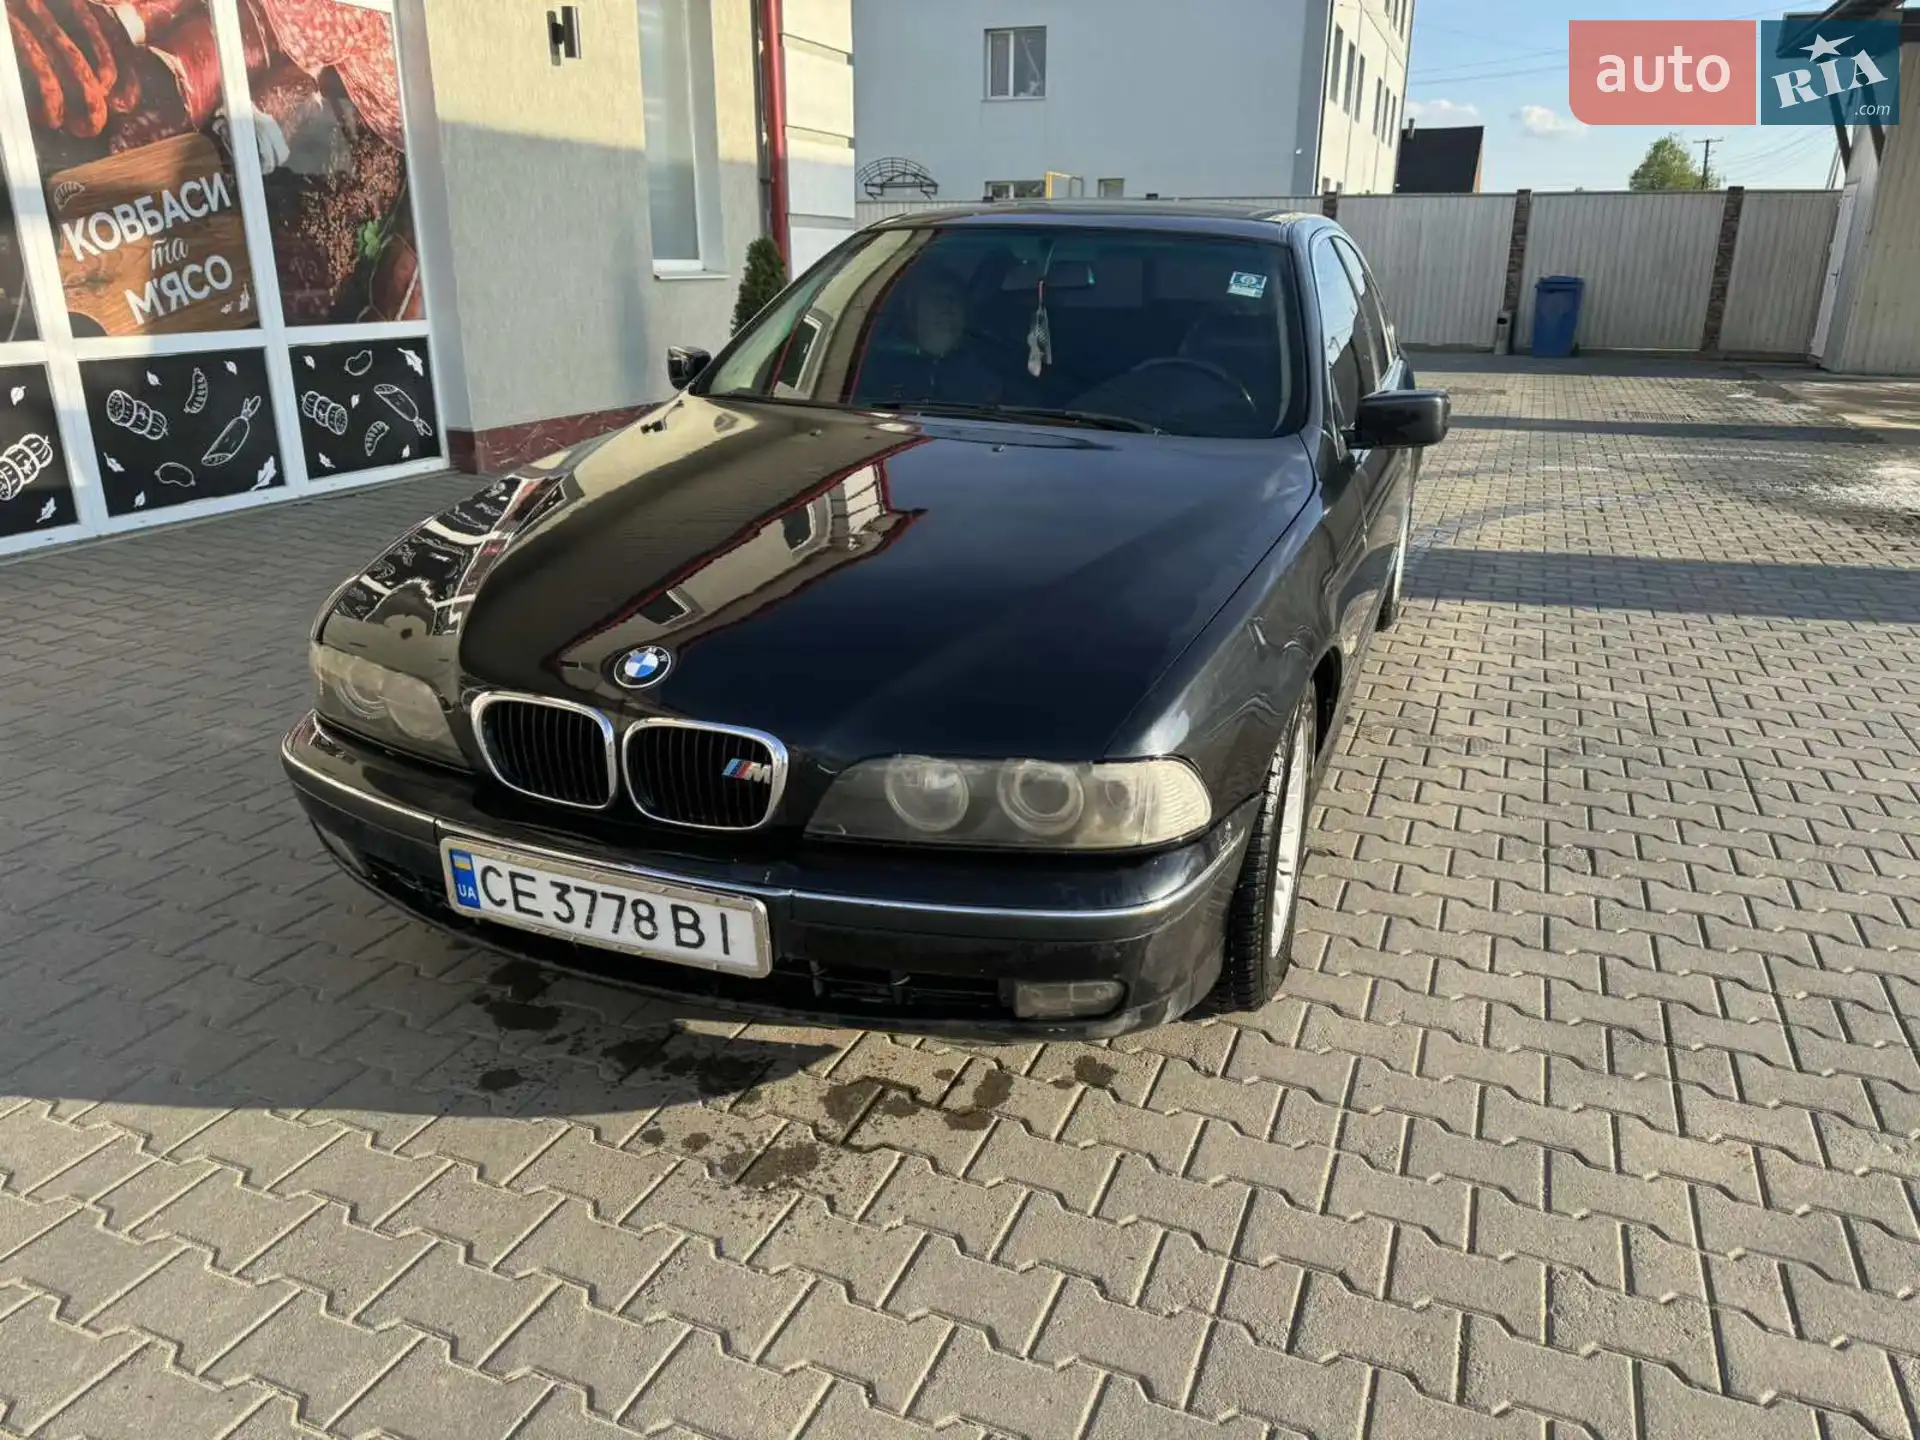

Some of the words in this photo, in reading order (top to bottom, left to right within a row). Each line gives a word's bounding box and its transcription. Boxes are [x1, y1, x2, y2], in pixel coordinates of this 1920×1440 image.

[61, 172, 232, 263] КОВБАСИ
[151, 237, 189, 271] та
[124, 255, 233, 326] М'ЯСО
[457, 883, 477, 901] UA
[480, 865, 544, 918] CE
[550, 880, 659, 941] 3778
[671, 903, 730, 956] BI
